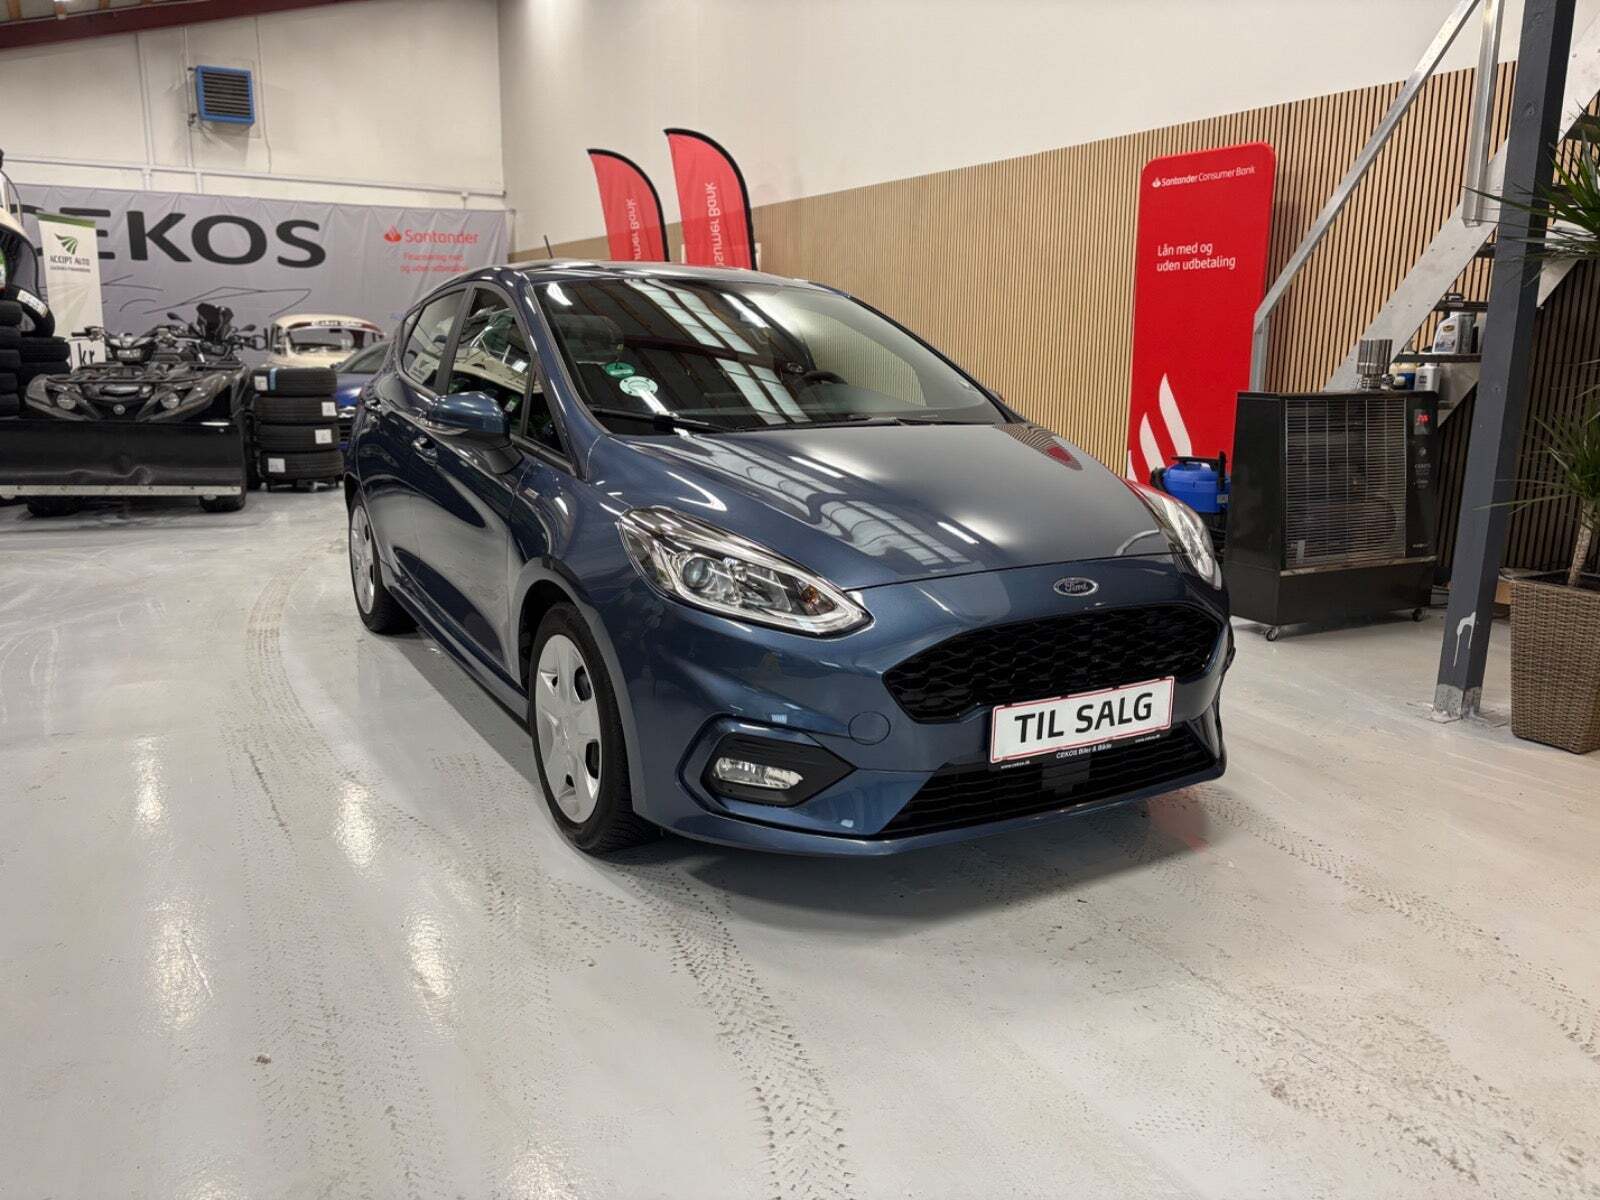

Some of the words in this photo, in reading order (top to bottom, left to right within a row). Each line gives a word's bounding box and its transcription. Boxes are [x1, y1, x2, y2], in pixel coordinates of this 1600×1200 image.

[1161, 174, 1199, 187] Santander
[1199, 168, 1235, 182] Consumer
[1236, 165, 1256, 177] Bank
[403, 228, 480, 244] Santander
[1157, 243, 1174, 257] Lån
[1176, 242, 1198, 255] med
[1200, 243, 1213, 256] og
[1157, 260, 1180, 272] uden
[1182, 256, 1236, 270] udbetaling
[1014, 709, 1064, 743] TIL
[1075, 692, 1153, 734] SALG
